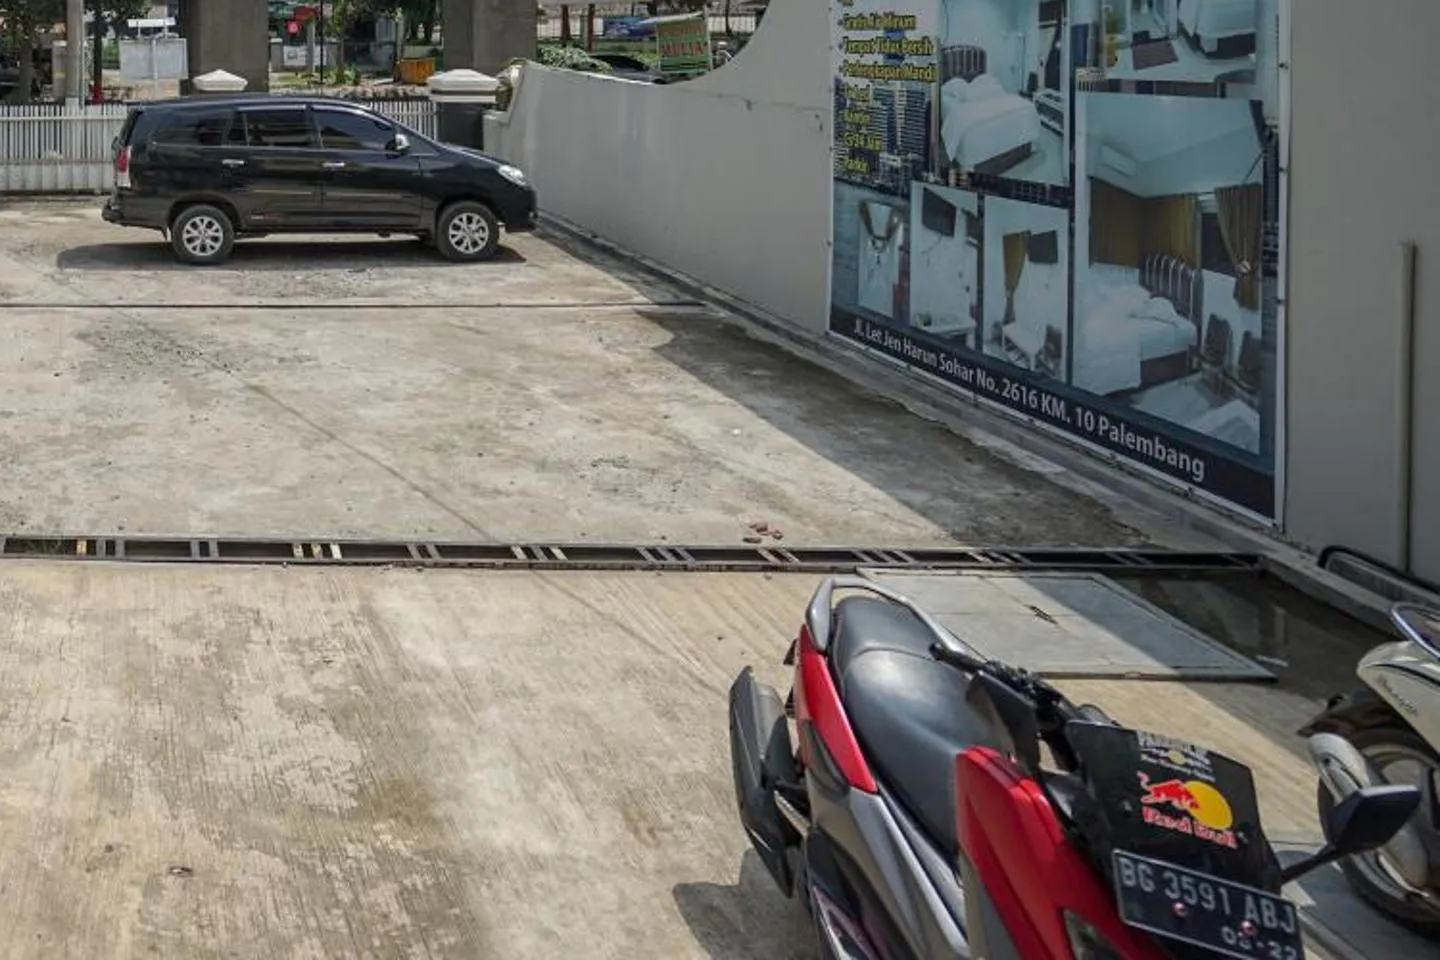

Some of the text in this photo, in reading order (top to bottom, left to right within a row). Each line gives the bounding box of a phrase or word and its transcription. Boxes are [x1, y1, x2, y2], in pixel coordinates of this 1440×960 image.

[903, 337, 938, 367] Harun
[939, 352, 974, 384] Sohar
[977, 367, 999, 392] No.
[1002, 378, 1038, 408] 2616
[1041, 392, 1071, 423] KM.
[1075, 406, 1096, 432] 10
[1099, 415, 1205, 482] Palembang
[1142, 805, 1239, 849] Red Bull
[1120, 857, 1296, 933] BG 3591 ABJ
